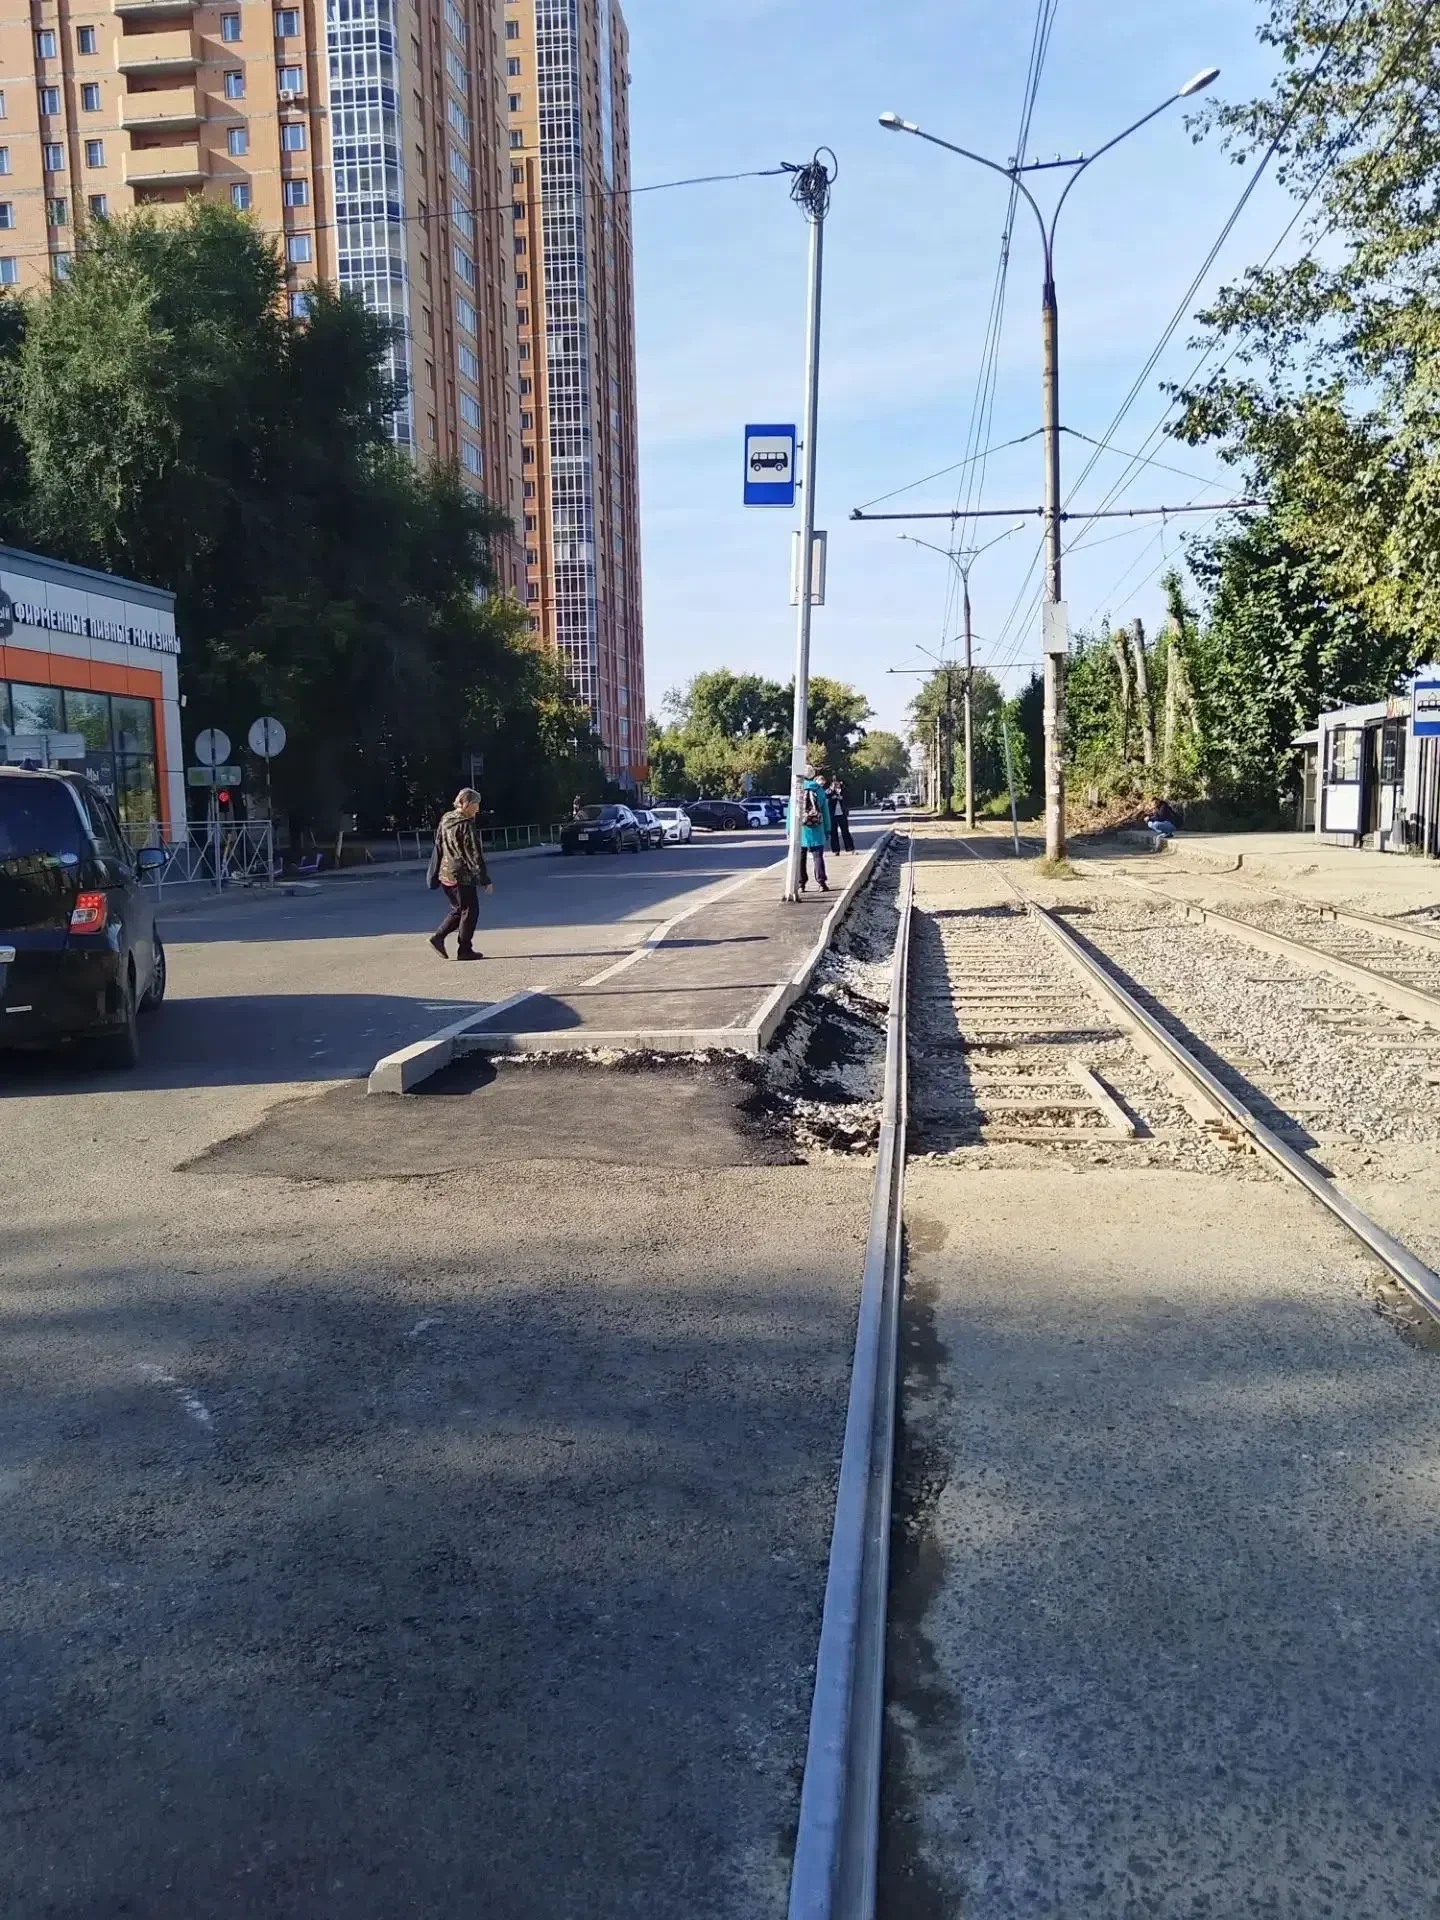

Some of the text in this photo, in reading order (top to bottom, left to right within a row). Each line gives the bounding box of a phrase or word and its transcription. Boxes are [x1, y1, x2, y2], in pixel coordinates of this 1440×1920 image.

[14, 602, 182, 654] ФИРМЕННЫЕ ПИВНЫЕ МАГАЗИНЫ
